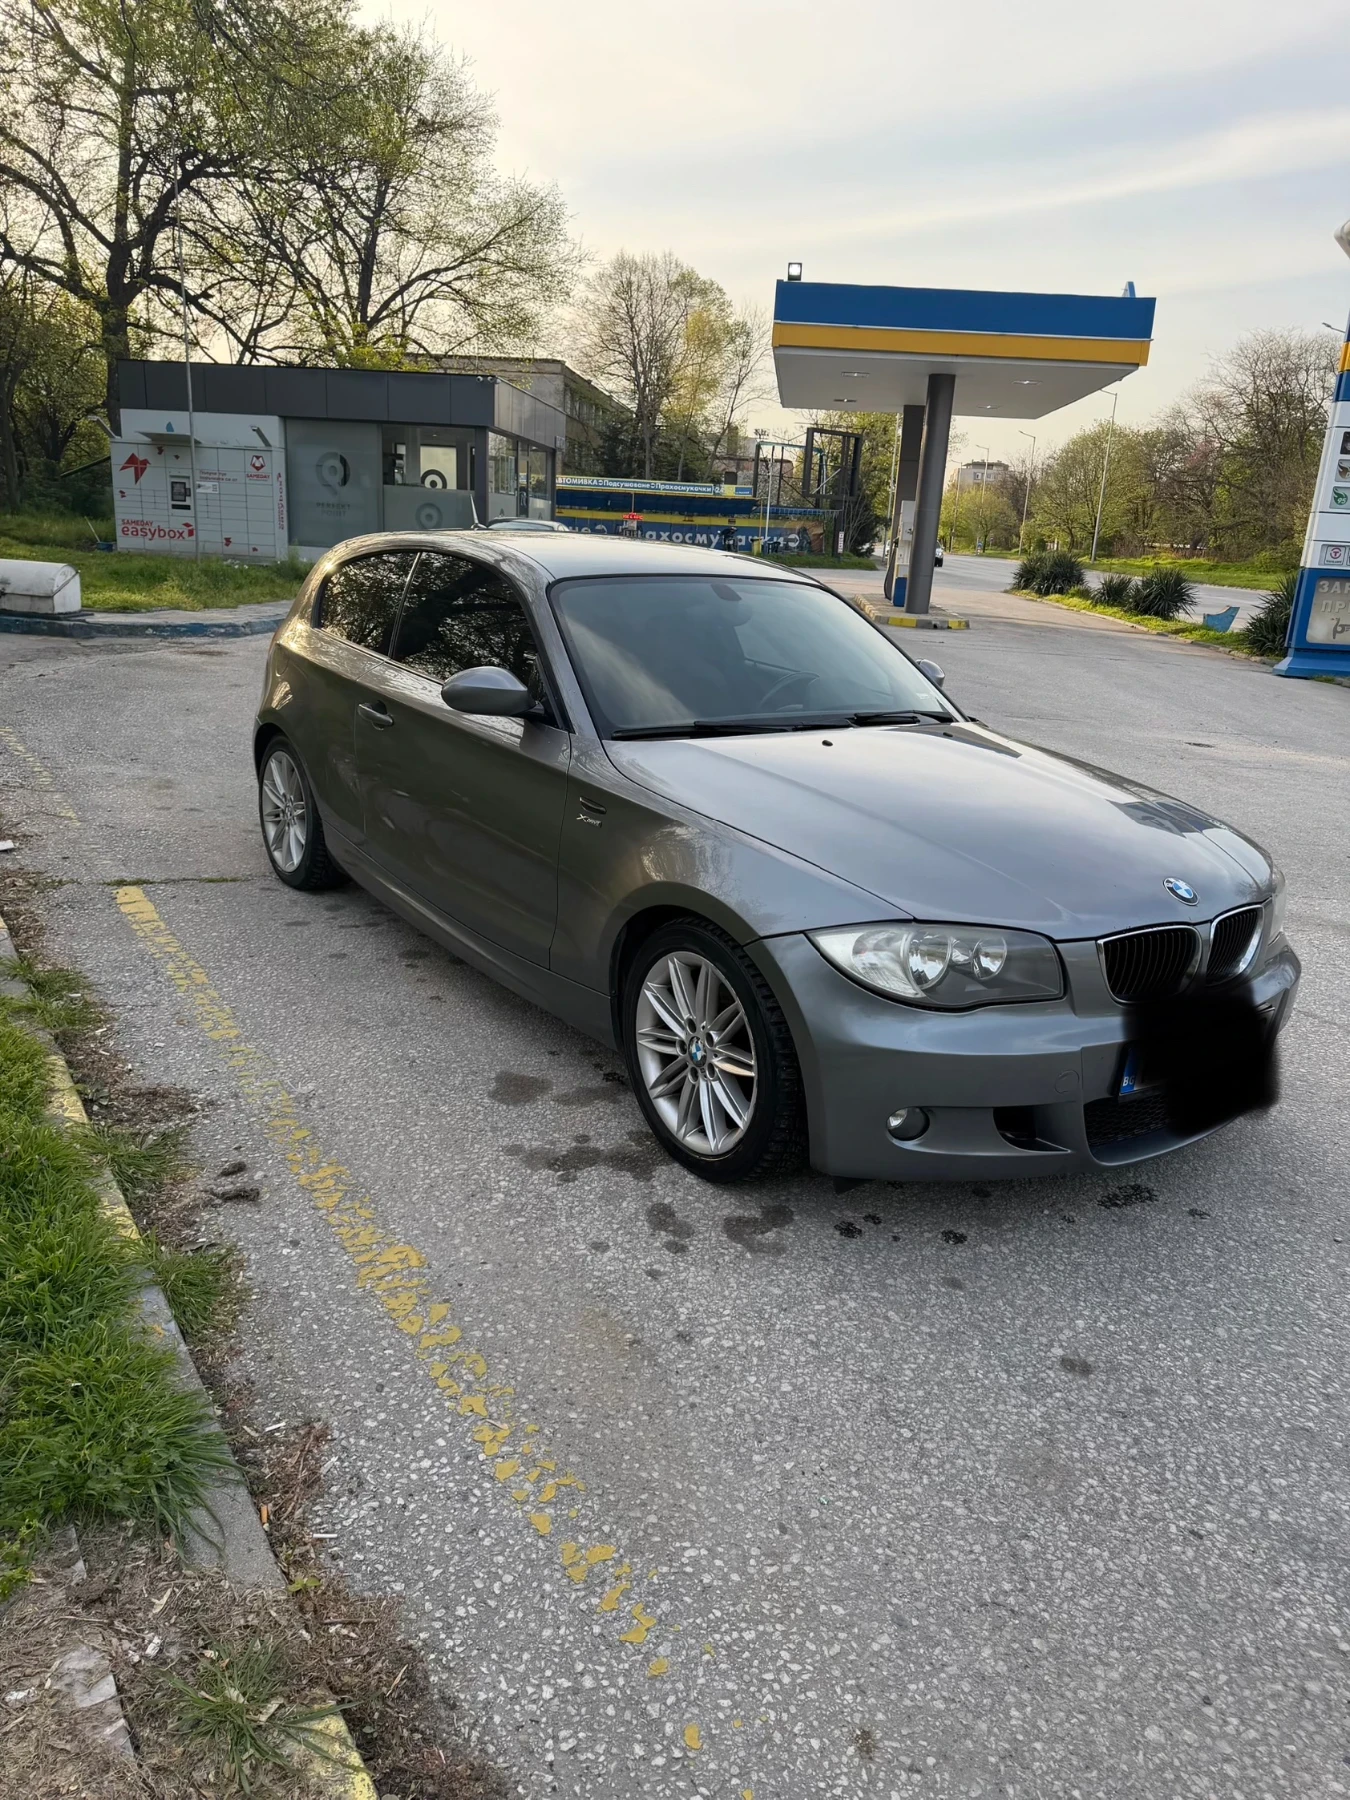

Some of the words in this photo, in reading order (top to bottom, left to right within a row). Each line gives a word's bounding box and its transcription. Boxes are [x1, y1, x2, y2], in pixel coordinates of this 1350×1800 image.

[121, 519, 154, 527] SAMEDAY
[121, 525, 185, 541] easybox
[1122, 1076, 1135, 1086] BG
